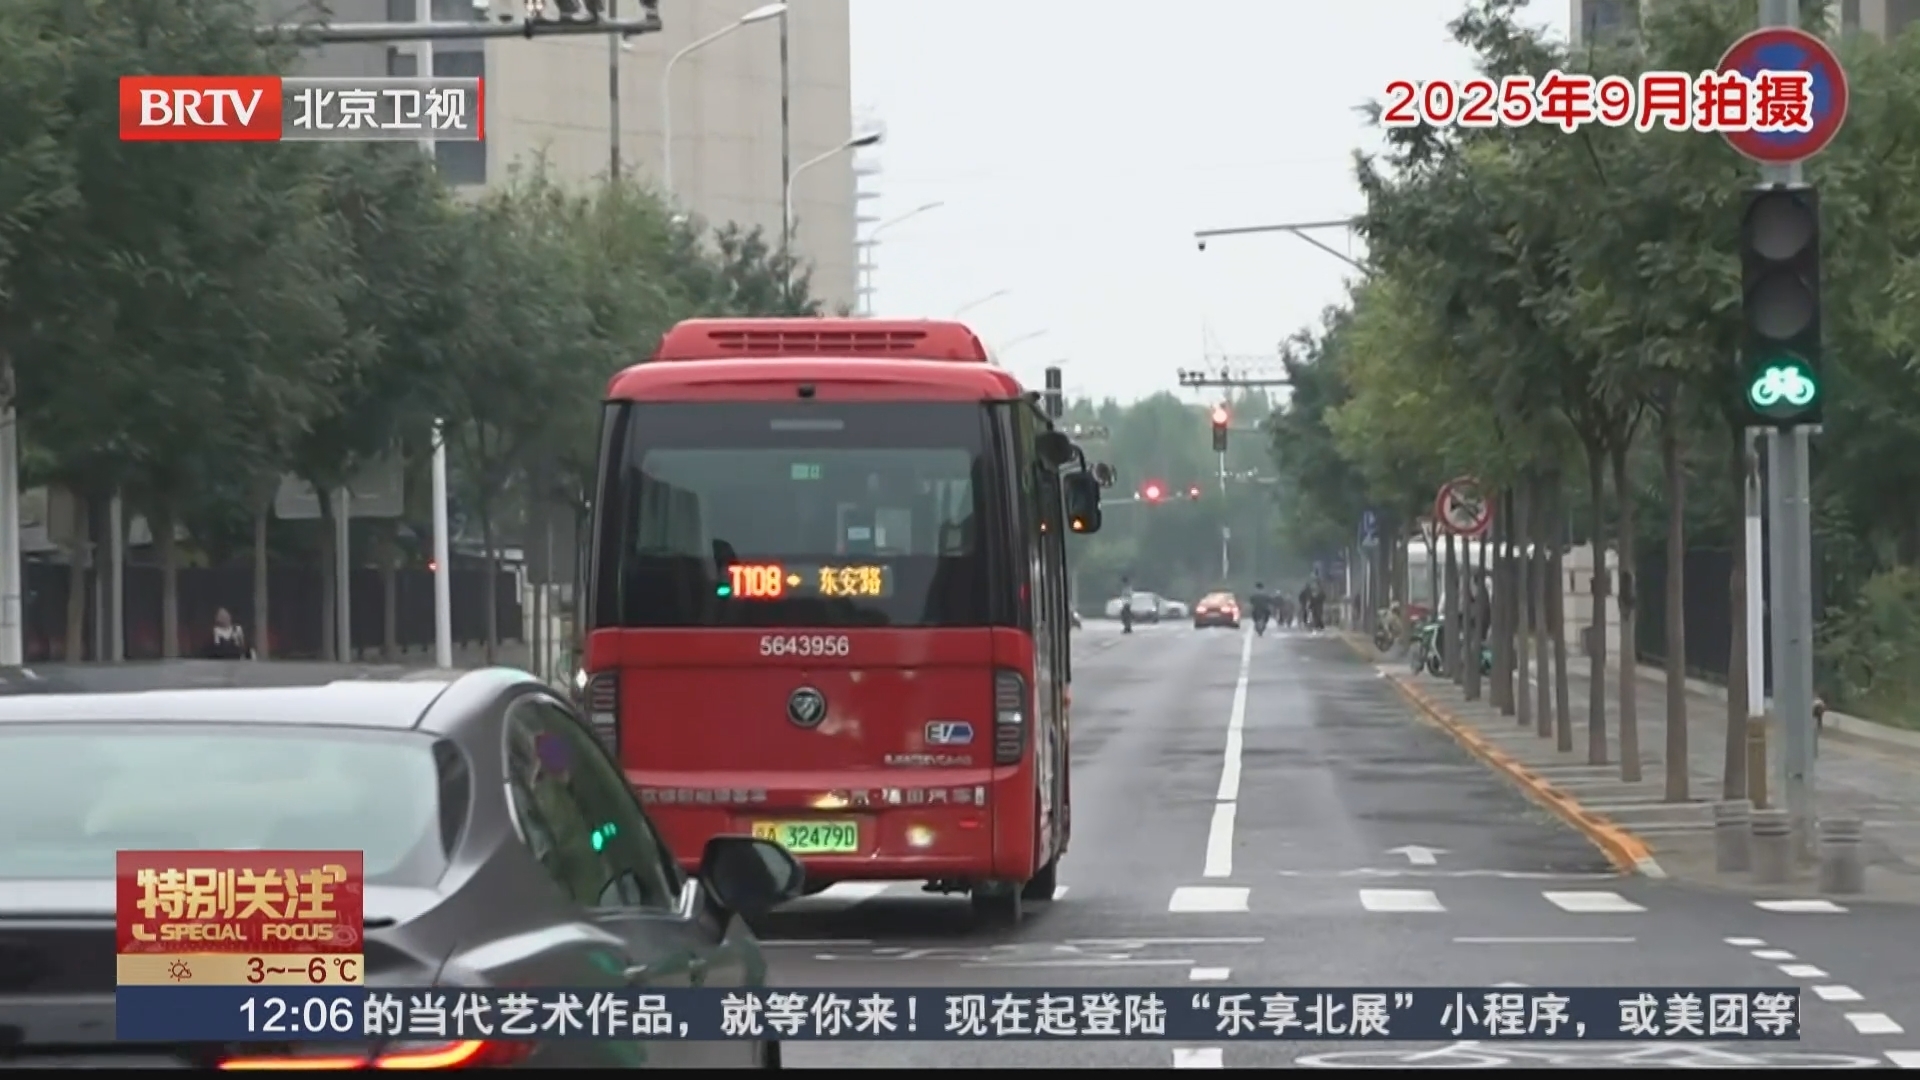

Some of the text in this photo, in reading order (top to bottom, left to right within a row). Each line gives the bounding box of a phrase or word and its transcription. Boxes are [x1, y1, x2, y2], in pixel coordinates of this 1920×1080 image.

[728, 564, 883, 598] T108 东安路
[759, 635, 850, 656] 5643956
